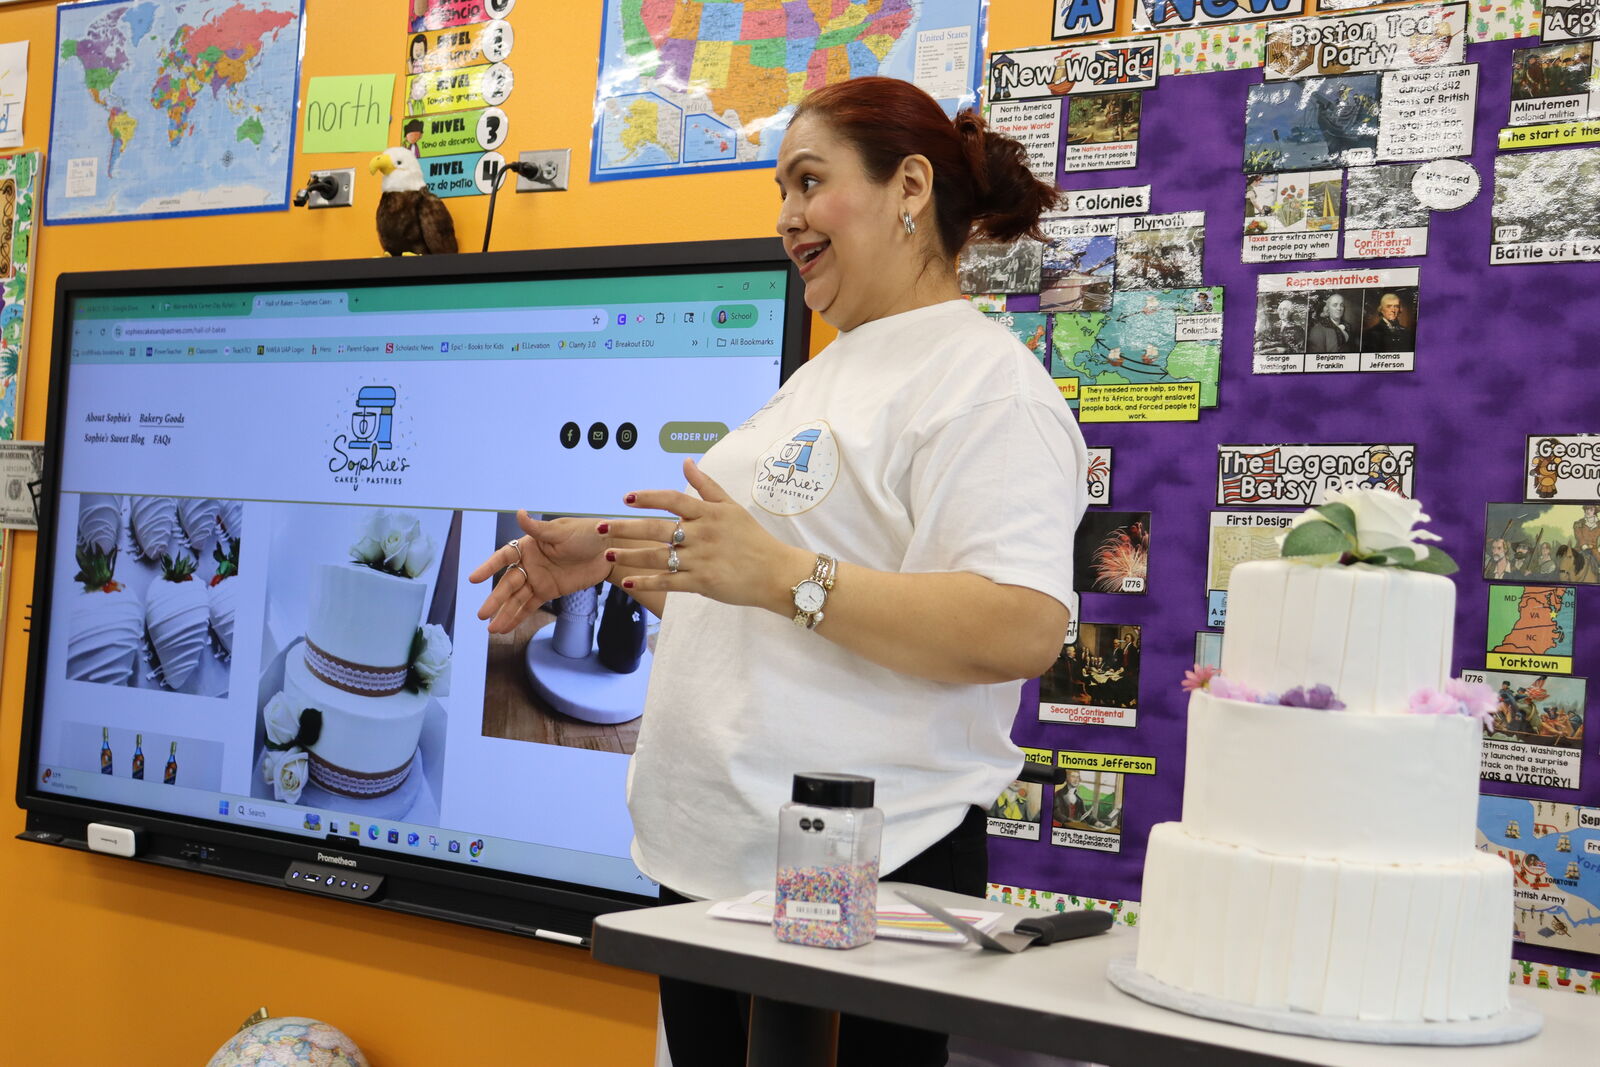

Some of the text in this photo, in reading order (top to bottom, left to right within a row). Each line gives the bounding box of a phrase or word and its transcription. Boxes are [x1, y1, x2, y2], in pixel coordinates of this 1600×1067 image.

[1291, 15, 1436, 46] Boston Tea
[919, 31, 968, 43] United States
[1322, 41, 1398, 68] Party
[1401, 69, 1471, 82] group men
[1441, 80, 1461, 90] 342
[1423, 92, 1470, 104] of British
[306, 83, 382, 132] north
[1000, 102, 1052, 113] North America
[1513, 98, 1580, 113] Minutemen
[995, 112, 1055, 123] used to be called
[1515, 110, 1575, 122] colonial militia
[431, 116, 500, 144] NIVEL 3
[1012, 124, 1029, 132] New
[1529, 129, 1560, 140] start
[1563, 127, 1578, 138] of
[1581, 126, 1600, 136] the
[438, 138, 447, 147] de
[448, 136, 475, 146] discurso
[1108, 152, 1128, 160] people
[1087, 160, 1105, 168] North
[429, 160, 499, 187] NIVEL 4
[437, 178, 473, 191] de patio
[1075, 193, 1144, 212] Colonies
[1248, 232, 1334, 243] Taxes extra money
[1371, 230, 1396, 239] First
[1498, 229, 1518, 238] 1775
[1250, 241, 1330, 252] that people pay when
[1354, 237, 1412, 248] Continental
[1260, 251, 1318, 261] they buy things.
[1358, 246, 1407, 257] Congress
[1495, 243, 1567, 260] Battle of
[1286, 273, 1380, 288] Representatives
[730, 312, 752, 321] School
[1177, 316, 1222, 327] Christopher
[1181, 326, 1218, 335] Columbus
[568, 341, 586, 350] Clarity
[615, 339, 654, 348] Breakout EDU
[730, 337, 775, 346] All Bookmarks
[362, 344, 379, 353] Square
[395, 344, 419, 352] Scholastic
[1265, 355, 1290, 364] George
[1315, 354, 1346, 363] Benjamin
[1369, 361, 1405, 369] Jefferson
[1177, 384, 1193, 392] they
[1111, 395, 1135, 403] Africa,
[1136, 394, 1163, 402] brought
[1164, 393, 1196, 401] enslaved
[1164, 403, 1188, 411] people
[85, 411, 132, 424] About Sophie's
[139, 412, 185, 425] Bakery Goods
[83, 432, 145, 446] Sophie's Sweet Blog
[152, 434, 172, 446] FAQs
[669, 431, 719, 442] ORDER UP!
[328, 434, 411, 476] Sophie's
[1220, 449, 1413, 479] The Legend of
[757, 456, 824, 492] Sophie's
[334, 476, 403, 485] CAKES PASTRIES
[756, 483, 815, 502] CAKES PASTRIES
[1239, 475, 1388, 506] Betsy Rss
[1226, 514, 1293, 529] First Design
[1124, 580, 1141, 589] 1776
[1504, 594, 1517, 602] MD
[1529, 611, 1540, 619] VA
[1500, 656, 1559, 670] Yorktown
[1464, 674, 1484, 684] 1776
[1050, 705, 1125, 719] Second Continental
[1068, 714, 1105, 724] Congress
[1060, 754, 1153, 771] Thomas Jefferson
[1490, 751, 1526, 762] launched
[1534, 756, 1569, 767] surprise
[1481, 760, 1502, 769] ttack
[1515, 764, 1529, 772] the
[1530, 765, 1558, 776] British.
[1516, 772, 1572, 789] VICTORY!
[249, 807, 266, 818] Search
[1000, 827, 1019, 836] Chief
[1052, 830, 1120, 844] Wrote Declaration
[1069, 837, 1113, 849] Independence
[317, 852, 357, 868] Promethean
[1544, 876, 1578, 887] YORKTOWN
[1541, 892, 1566, 905] Army
